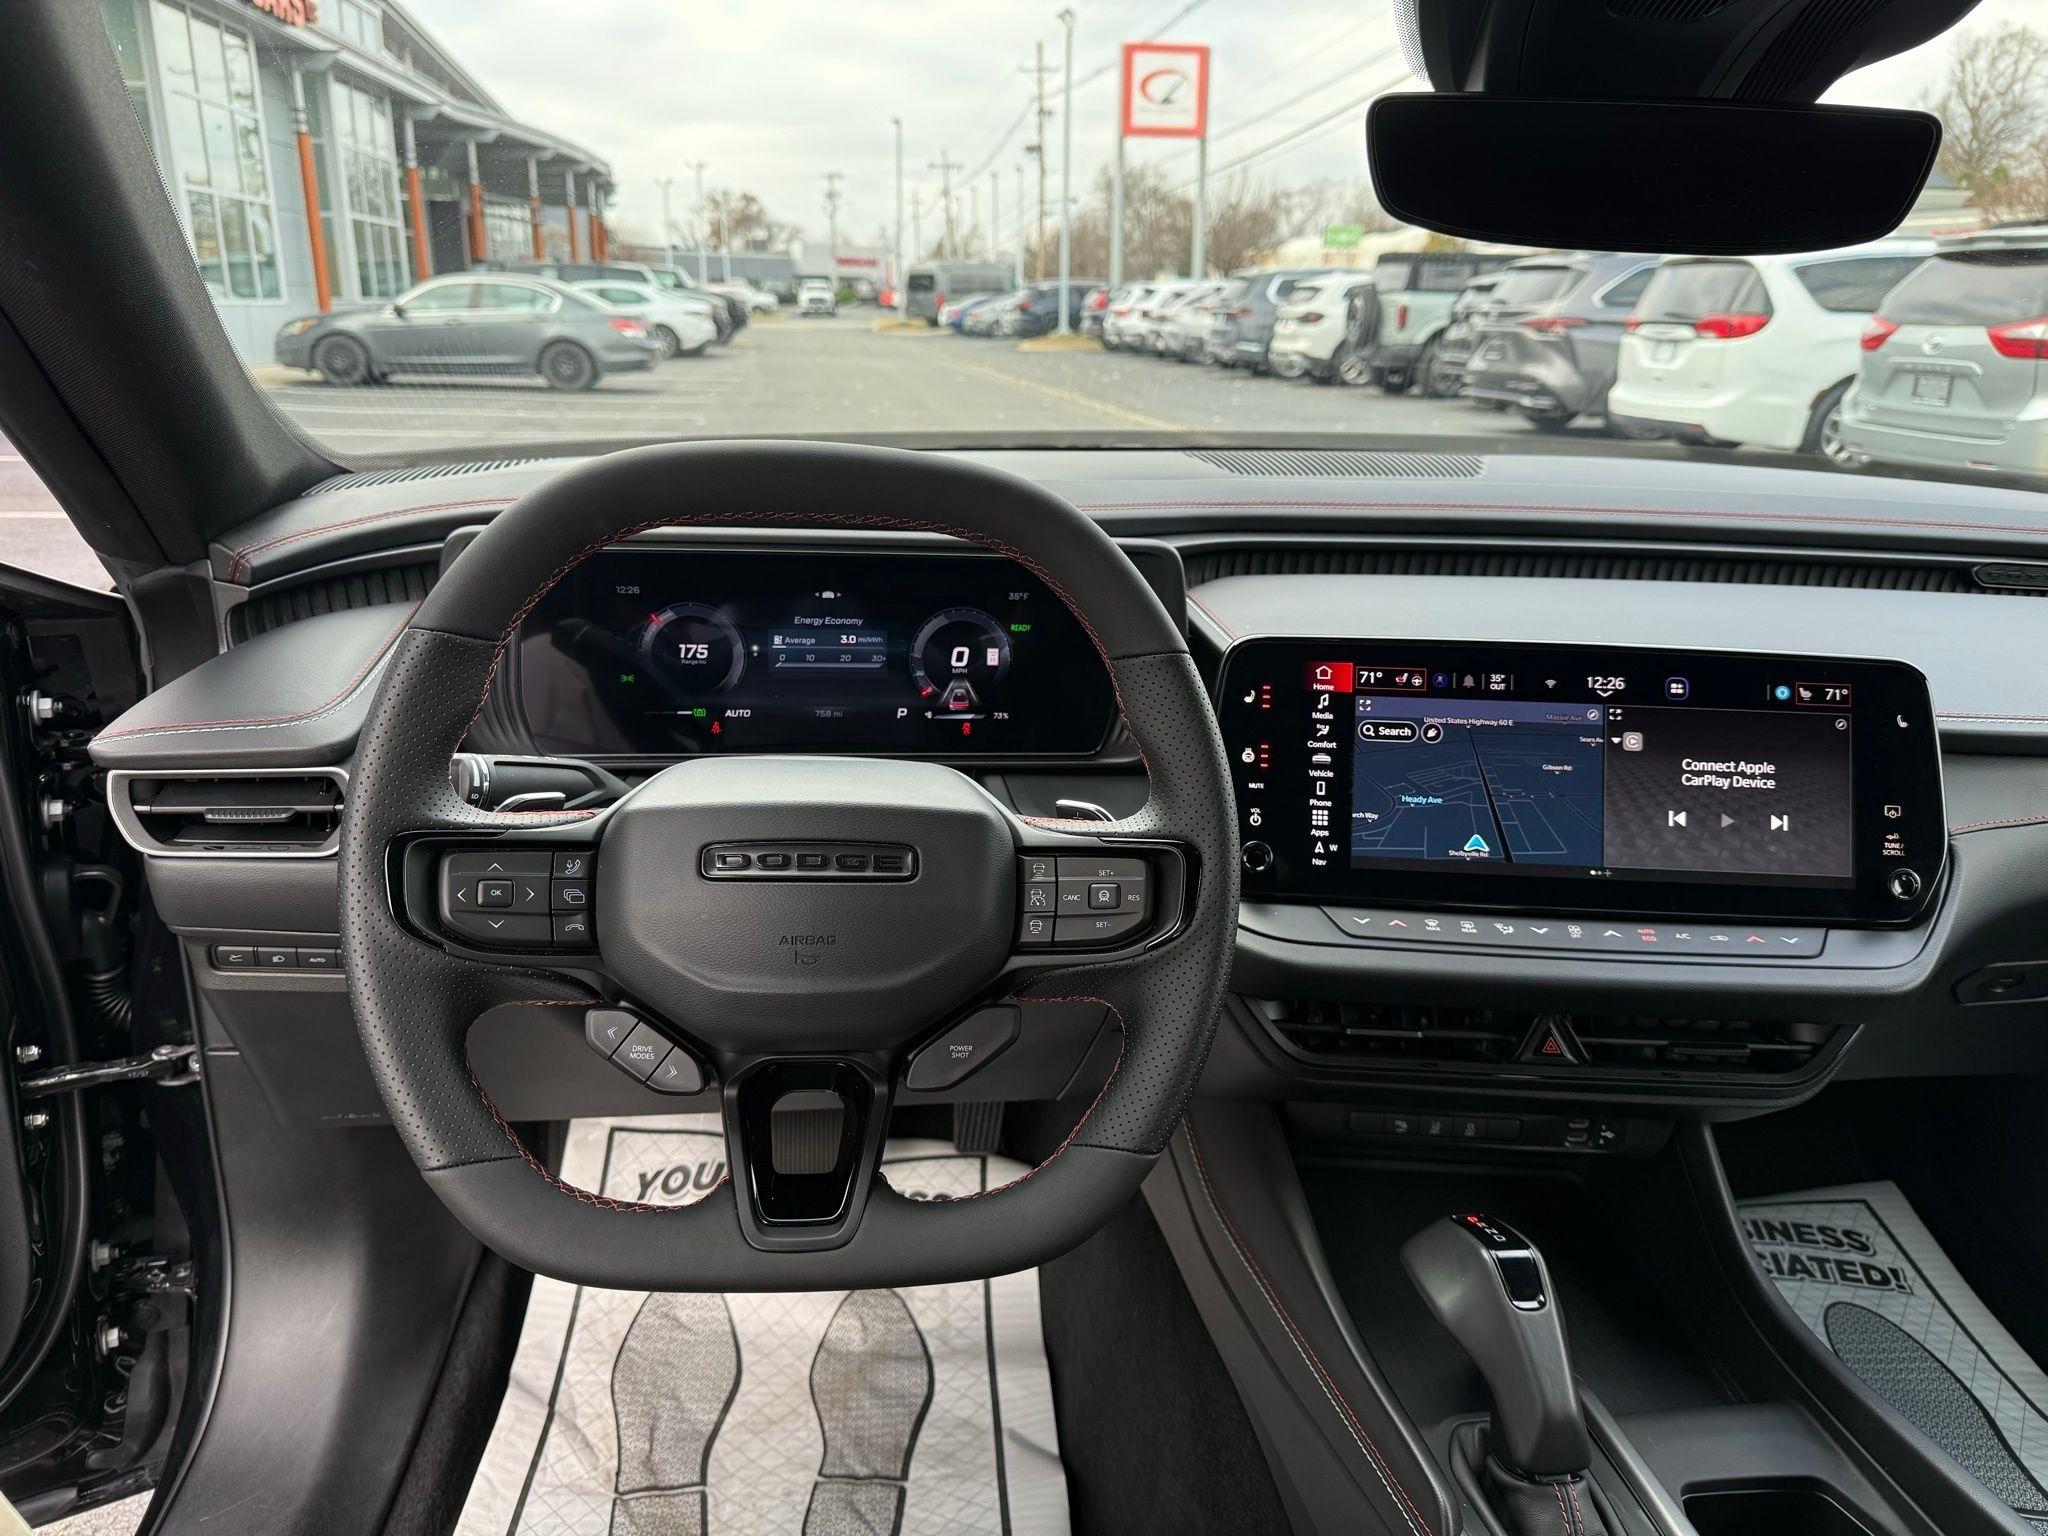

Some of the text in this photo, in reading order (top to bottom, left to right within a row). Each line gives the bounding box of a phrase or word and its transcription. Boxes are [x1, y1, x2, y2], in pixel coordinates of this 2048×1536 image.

[616, 586, 640, 594] 12:26
[794, 616, 863, 626] Energy Economy
[1011, 624, 1032, 632] READY
[784, 637, 816, 646] Average
[840, 635, 857, 644] 3.0
[678, 643, 709, 659] 175
[779, 654, 786, 662] 0
[806, 654, 815, 662] 10
[950, 646, 970, 667] 0
[1359, 671, 1383, 684] 71°
[1313, 683, 1335, 691] Home
[1490, 683, 1506, 691] OUT
[1587, 676, 1626, 690] 12:26
[1825, 688, 1848, 701] 71°
[725, 709, 752, 718] AUTO
[833, 710, 843, 718] mi
[897, 707, 907, 719] P
[993, 712, 1009, 720] 73%
[1312, 711, 1334, 720] Media
[1468, 718, 1499, 727] Highway
[1378, 726, 1412, 737] Search
[1307, 740, 1337, 749] Comfort
[1682, 758, 1776, 775] Connect Apple
[1308, 769, 1334, 778] Vehicle
[1681, 773, 1776, 789] CarPlay Device
[1309, 798, 1332, 807] Phone
[1401, 795, 1443, 805] Heady Ave
[1310, 829, 1329, 838] Apps
[1882, 849, 1906, 857] SCROLL
[716, 852, 903, 873] DODGE
[1311, 858, 1327, 866] Nav
[490, 888, 502, 896] OK
[779, 934, 837, 946] AIRBAG
[632, 1045, 654, 1053] DRIVE
